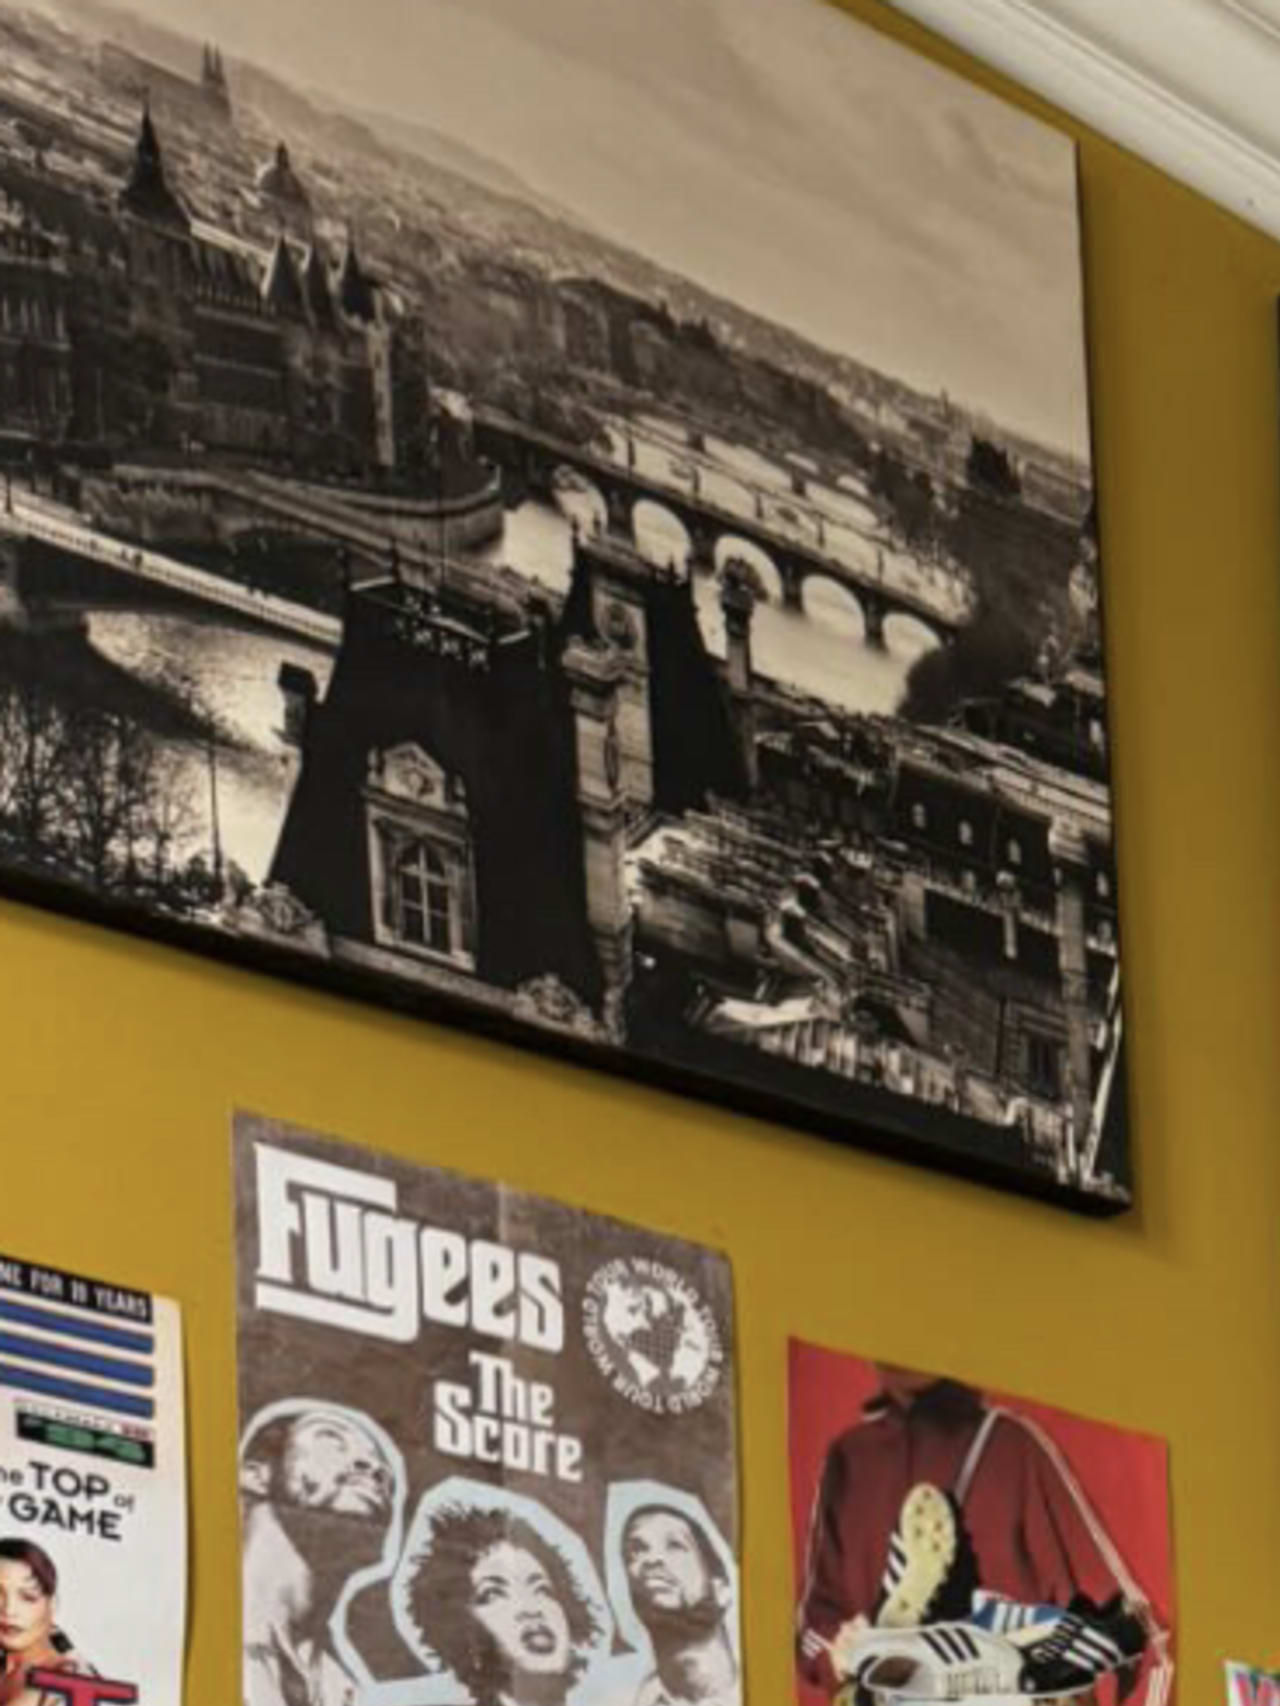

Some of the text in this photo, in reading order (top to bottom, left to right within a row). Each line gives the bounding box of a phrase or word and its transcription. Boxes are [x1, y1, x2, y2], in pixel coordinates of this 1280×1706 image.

[255, 1142, 564, 1353] Fugees
[30, 1270, 64, 1296] FOR
[96, 1284, 148, 1318] YEARS
[470, 1350, 555, 1428] The
[433, 1381, 584, 1482] Score
[28, 1460, 110, 1500] TOP
[8, 1492, 122, 1541] GAME
